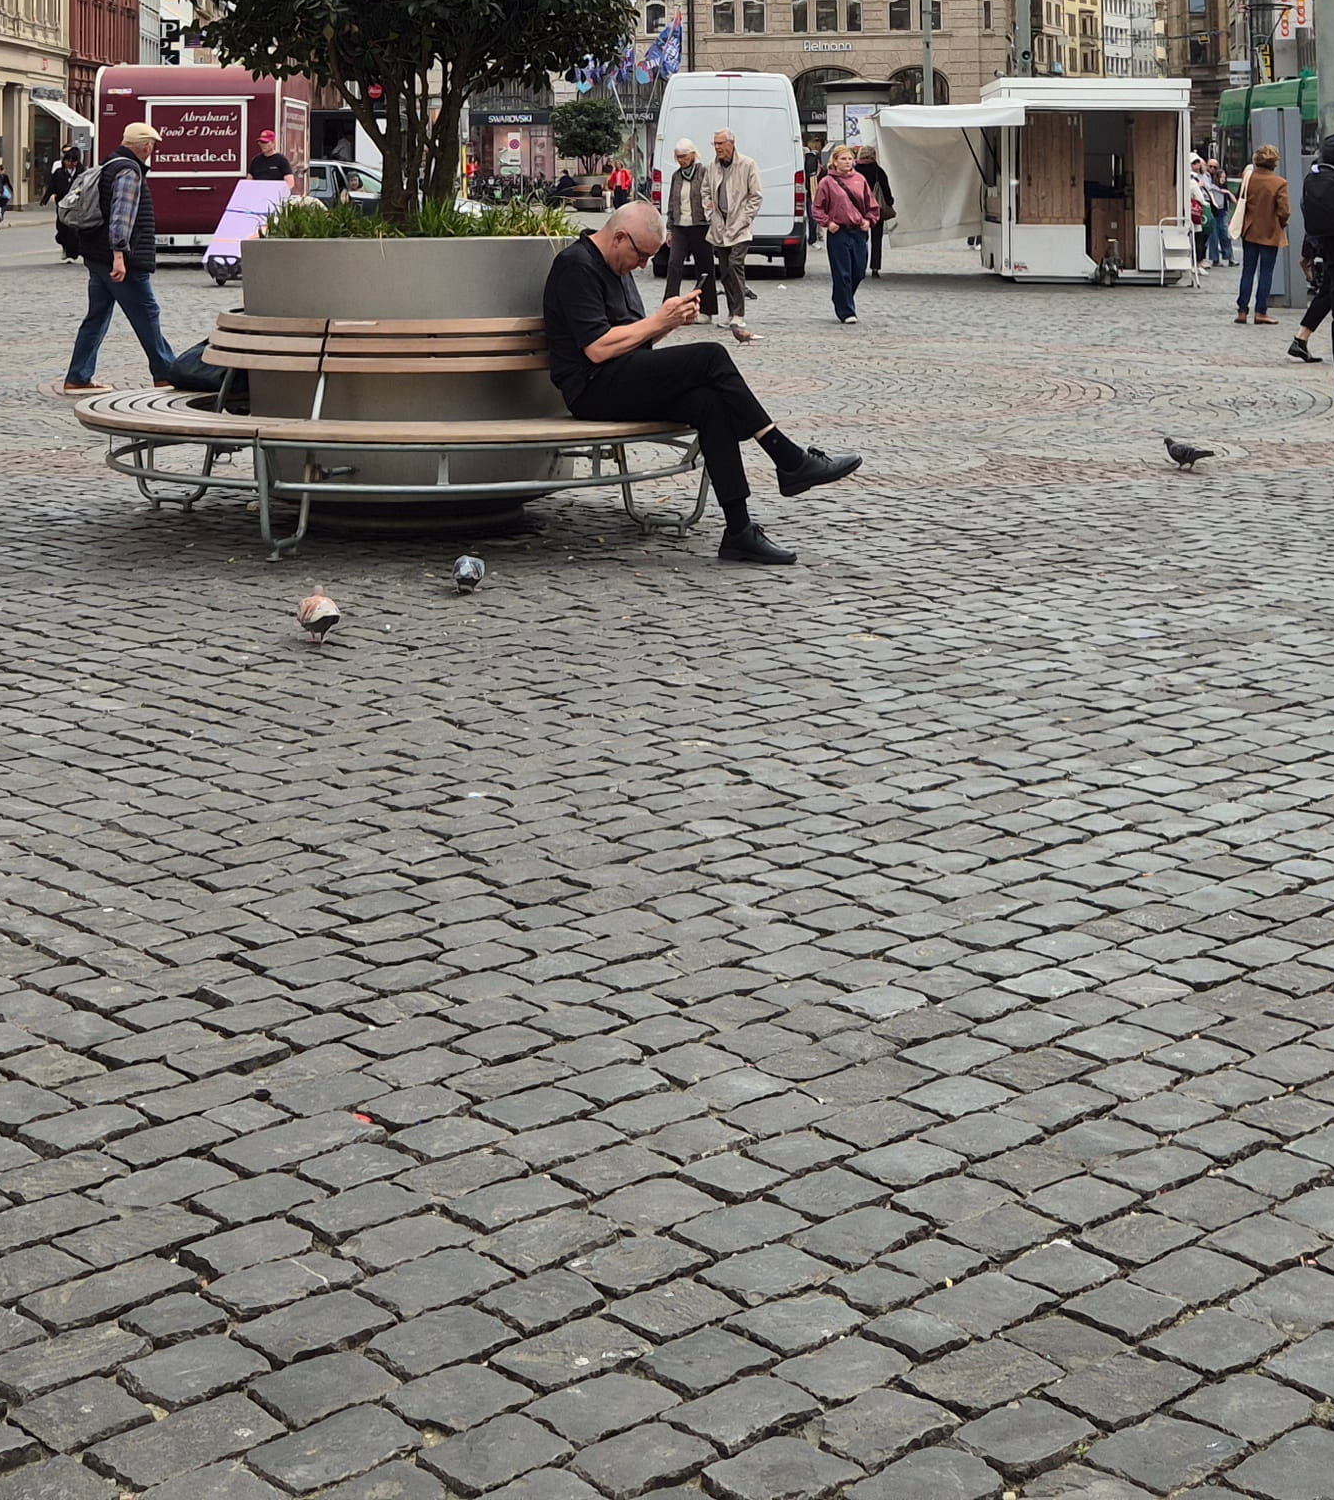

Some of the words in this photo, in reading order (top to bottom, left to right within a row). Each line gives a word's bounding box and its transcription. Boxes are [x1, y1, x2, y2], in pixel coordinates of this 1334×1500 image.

[180, 111, 238, 122] Abraham's
[488, 114, 533, 124] SWAROVSKI
[159, 125, 184, 137] Food
[201, 125, 238, 136] Drinks
[154, 149, 236, 163] isratrade.ch
